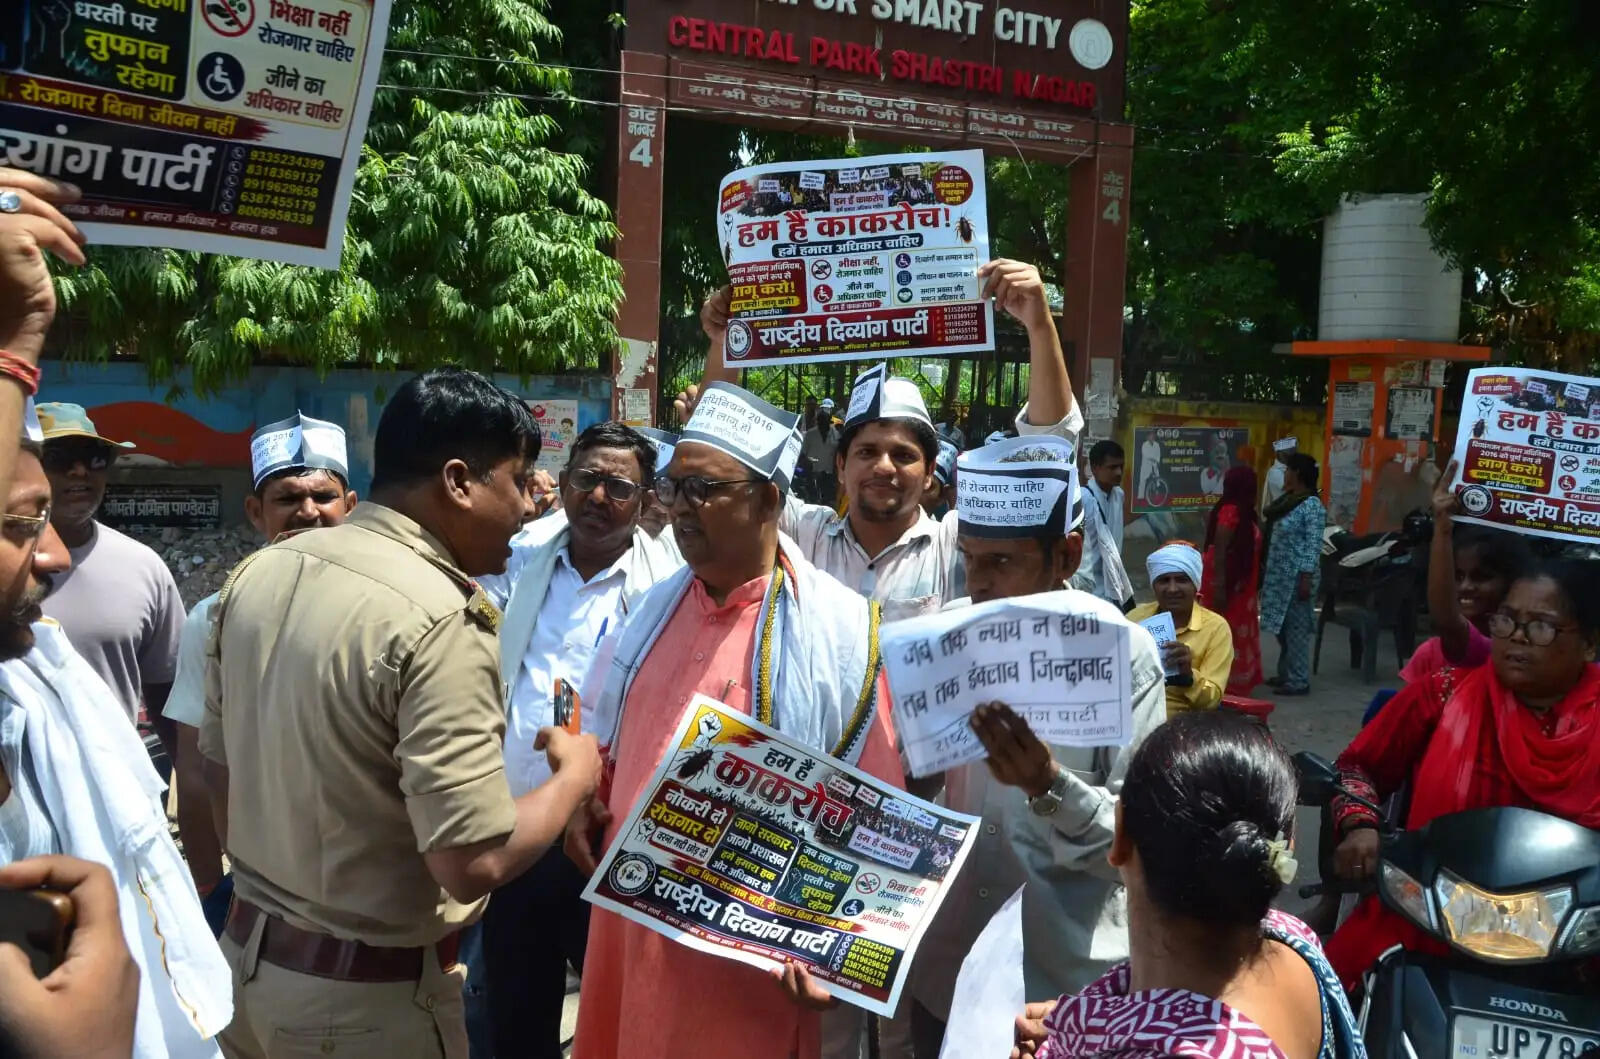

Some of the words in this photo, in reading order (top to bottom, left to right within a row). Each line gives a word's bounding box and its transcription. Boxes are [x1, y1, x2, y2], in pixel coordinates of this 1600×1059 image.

[75, 1, 126, 26] धरती
[130, 12, 158, 32] पर
[319, 11, 352, 36] नहीं
[872, 0, 983, 35] SMART
[995, 8, 1062, 48] CITY
[258, 22, 312, 52] रोजगार
[316, 39, 355, 62] चाहिए
[116, 62, 176, 93] रहेगा
[669, 16, 800, 63] CENTRAL
[810, 37, 882, 76] PARK
[891, 50, 1003, 93] SHASTRI
[1013, 70, 1097, 108] NAGAR
[266, 65, 300, 91] जीने
[304, 76, 326, 96] का
[20, 79, 97, 112] रोजगार
[103, 93, 145, 120] बिना
[149, 104, 198, 129] जीवन
[204, 115, 237, 135] नहीं
[244, 88, 303, 115] अधिकार
[305, 101, 343, 123] चाहिए
[121, 143, 216, 193] पार्टी
[630, 138, 653, 168] 4
[1103, 199, 1120, 226] 4
[737, 221, 779, 248] हम
[784, 209, 809, 244] हैं
[800, 243, 833, 256] हमारा
[836, 240, 882, 253] अधिकार
[885, 236, 920, 249] चाहिए
[758, 319, 822, 348] राष्ट्रीय
[826, 315, 888, 341] दिव्यांग
[892, 310, 928, 336] पार्टी
[747, 411, 773, 432] 2016
[1497, 410, 1540, 431] हम
[1545, 410, 1567, 439] हैं
[968, 480, 1009, 494] रोजगार
[1013, 481, 1045, 494] चाहिए
[965, 496, 1007, 510] अधिकार
[1010, 496, 1042, 510] चाहिए
[1500, 499, 1559, 521] राष्ट्रीय
[938, 628, 969, 656] तक
[978, 617, 1022, 643] न्याय
[1032, 615, 1049, 637] न
[1060, 610, 1101, 636] होगा
[934, 675, 961, 705] तक
[1030, 650, 1113, 687] जिन्दाबाद
[763, 747, 797, 773] हम
[794, 758, 816, 782] हैं
[715, 751, 855, 838] काकरोच
[650, 803, 704, 837] रोजगार
[703, 825, 721, 844] दो
[710, 807, 728, 825] दो
[735, 817, 760, 835] जागो
[726, 832, 752, 851] जागो
[751, 841, 788, 868] प्रशासन
[728, 867, 760, 889] अधिकार
[823, 879, 836, 891] पर
[655, 877, 721, 921] राष्ट्रीय
[720, 902, 793, 943] दिव्यांग
[791, 930, 839, 956] पार्टी
[1488, 996, 1569, 1023] HONDA
[1459, 1044, 1478, 1056] IND
